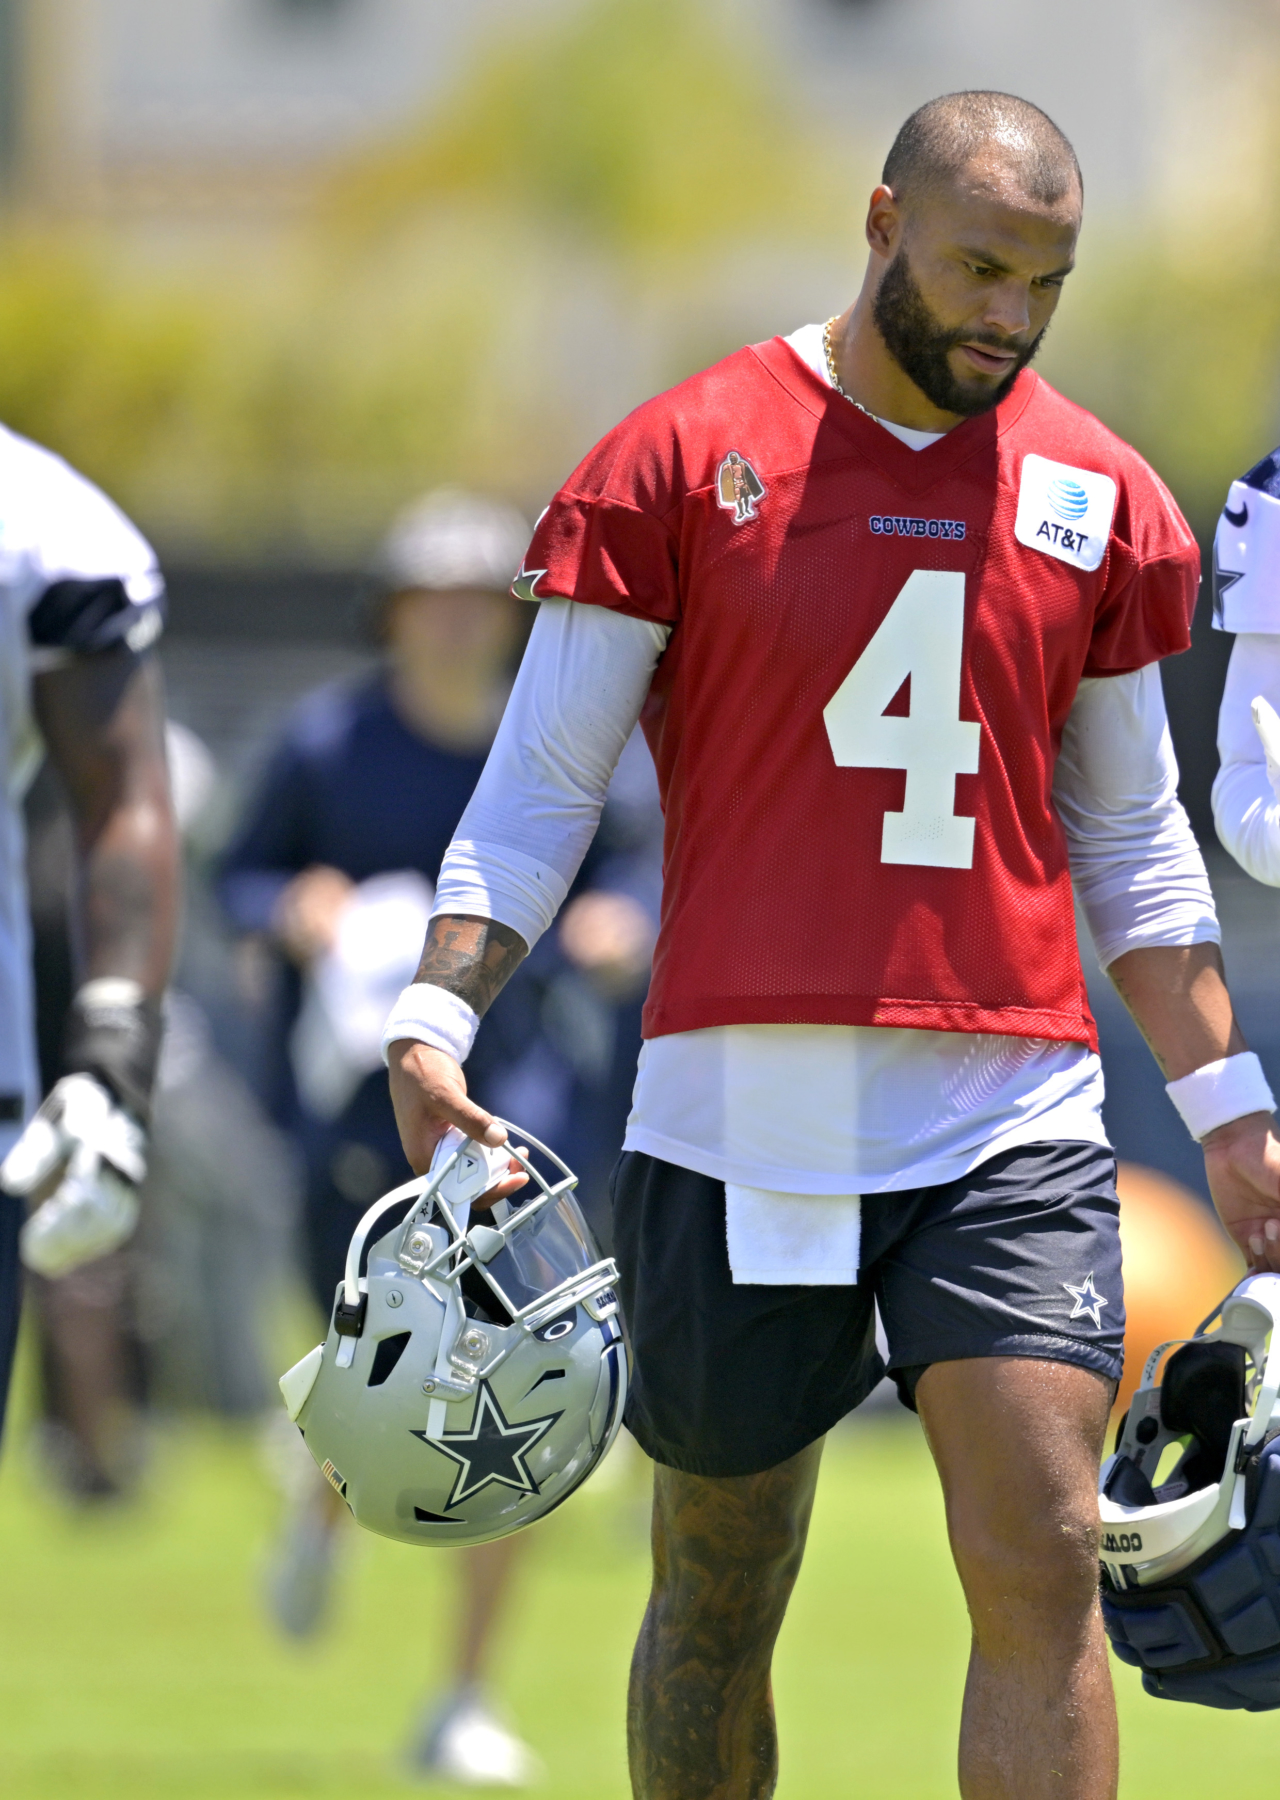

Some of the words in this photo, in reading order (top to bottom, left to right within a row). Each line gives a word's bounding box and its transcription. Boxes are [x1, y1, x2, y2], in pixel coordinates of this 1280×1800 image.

[869, 516, 966, 541] COWBOYS
[1036, 520, 1089, 552] AT&T
[823, 569, 981, 869] 4
[1102, 1532, 1143, 1553] COW
